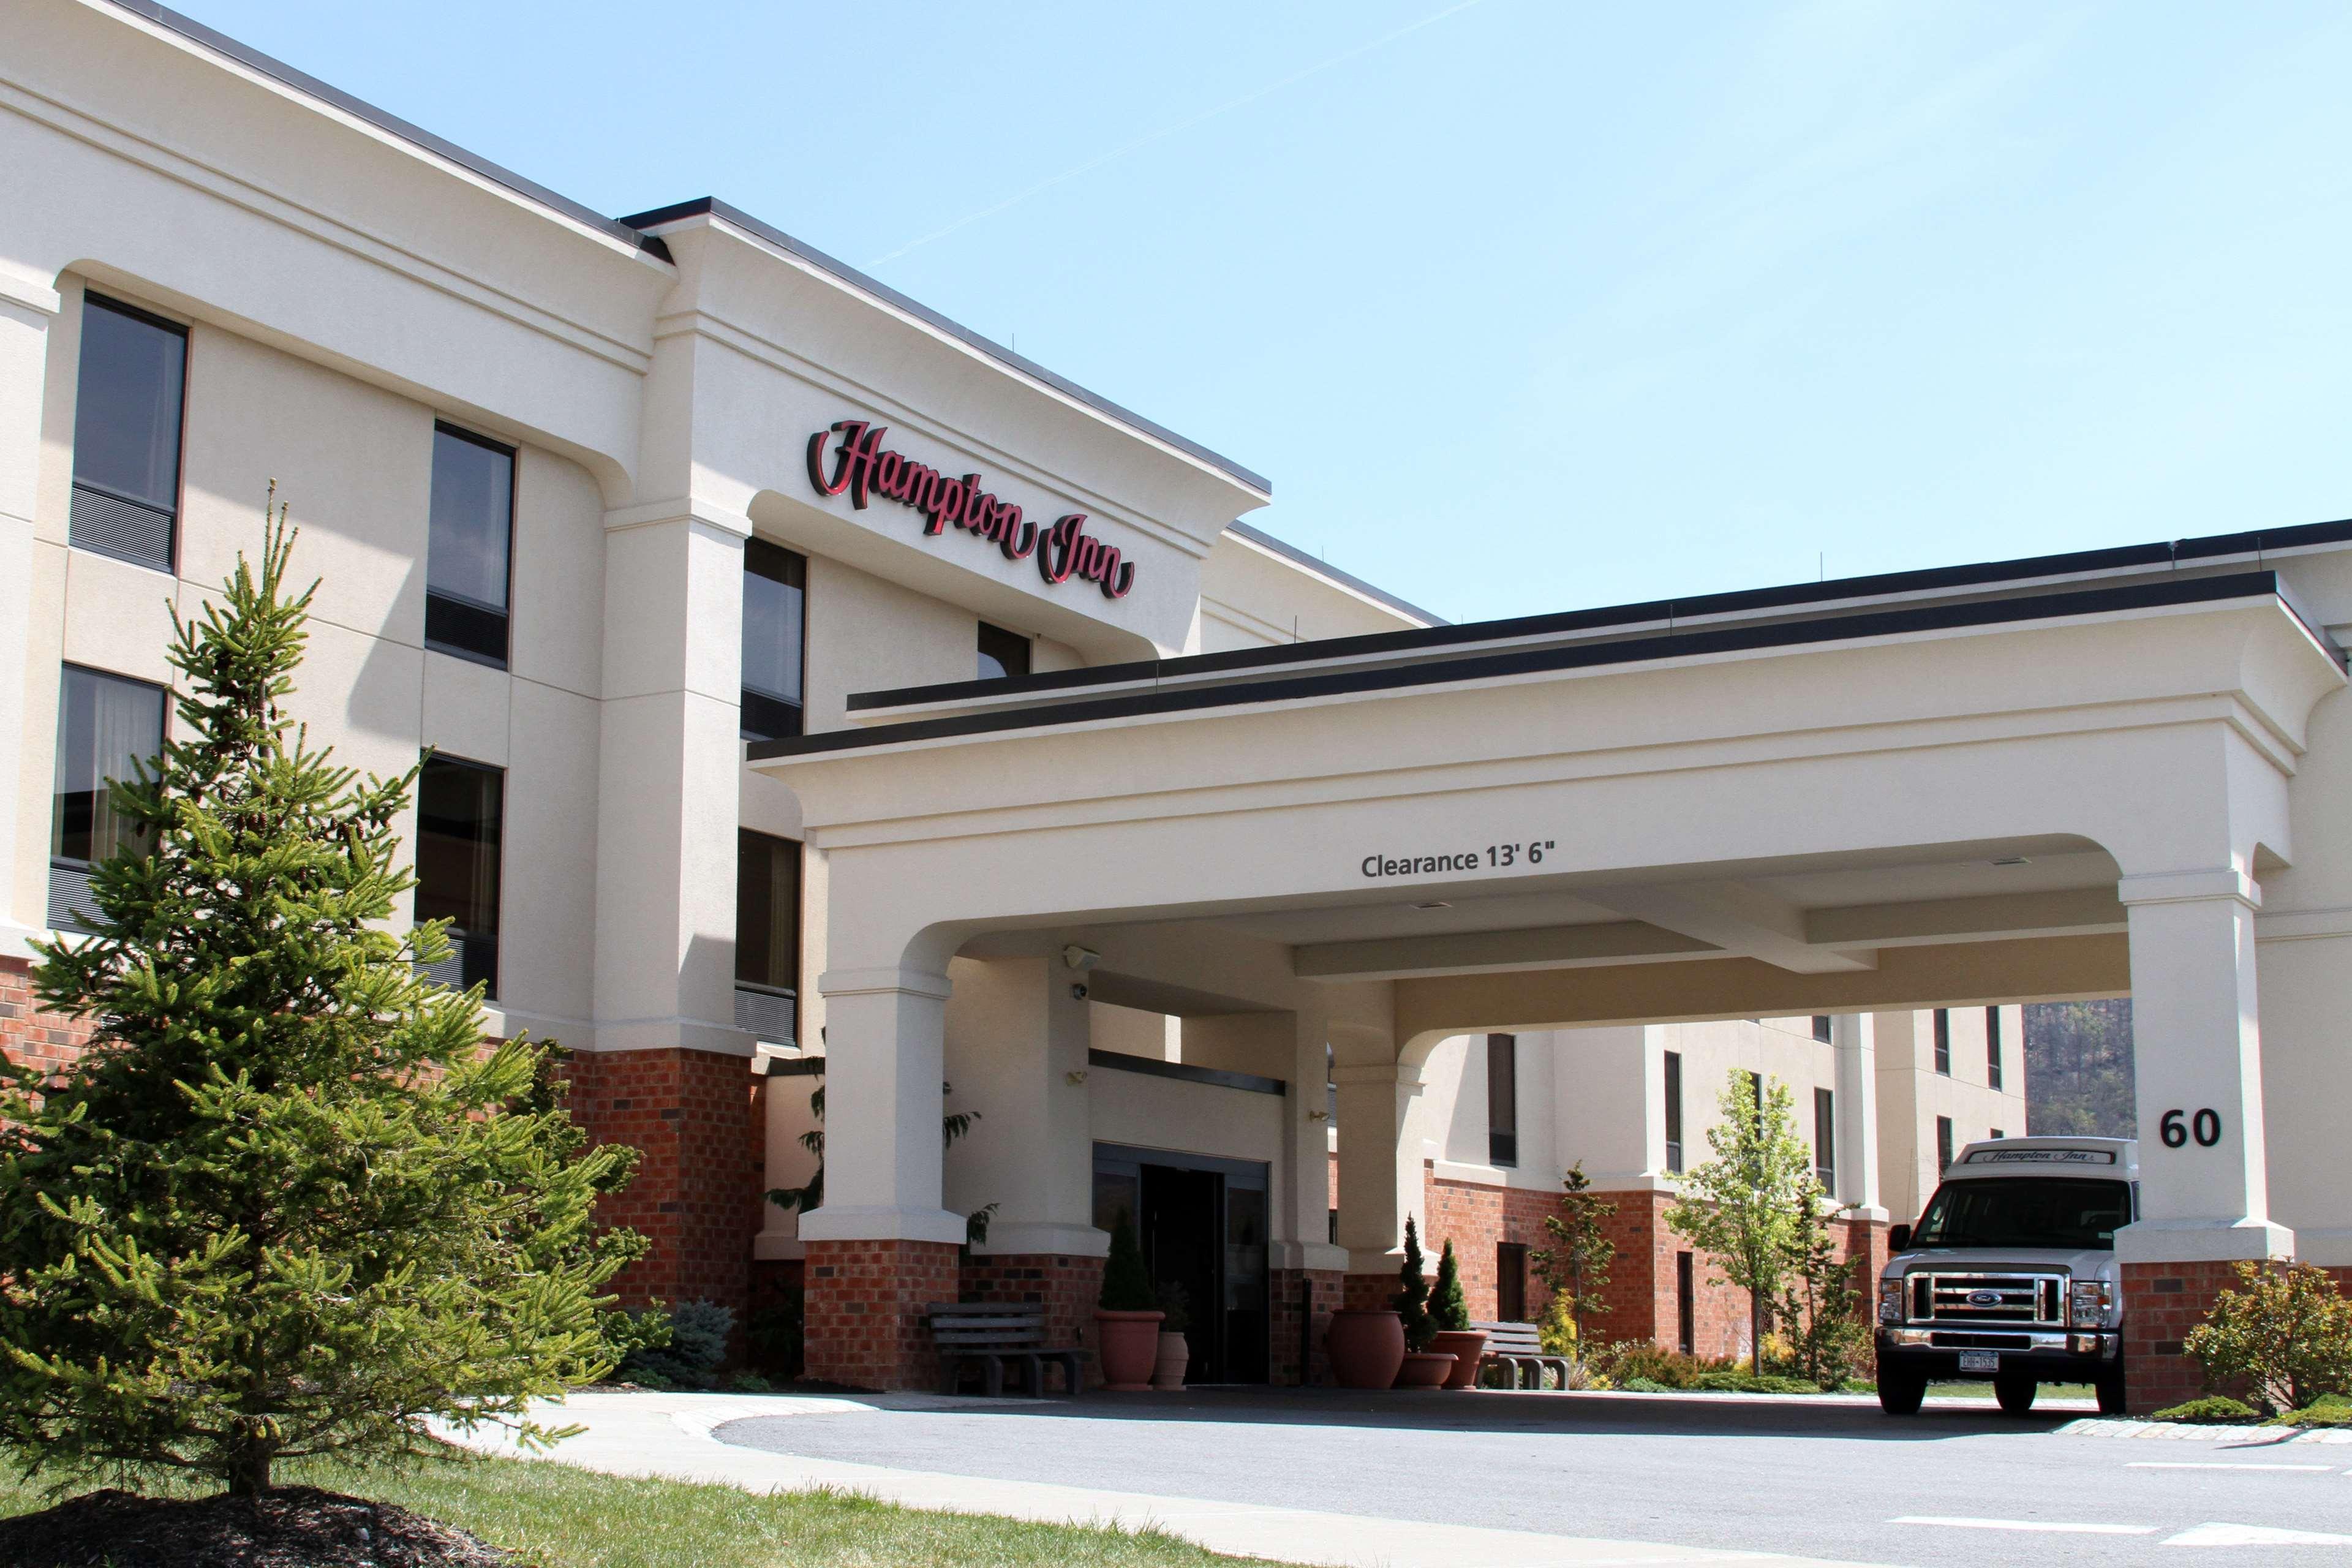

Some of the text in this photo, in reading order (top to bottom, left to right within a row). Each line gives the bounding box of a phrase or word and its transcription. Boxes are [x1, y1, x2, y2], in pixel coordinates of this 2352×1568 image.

[807, 420, 1135, 599] Hampton Inn
[1362, 840, 1555, 877] Clearance 13' 6"
[2160, 1108, 2220, 1148] 60
[1983, 1151, 2090, 1162] Hampton Inn
